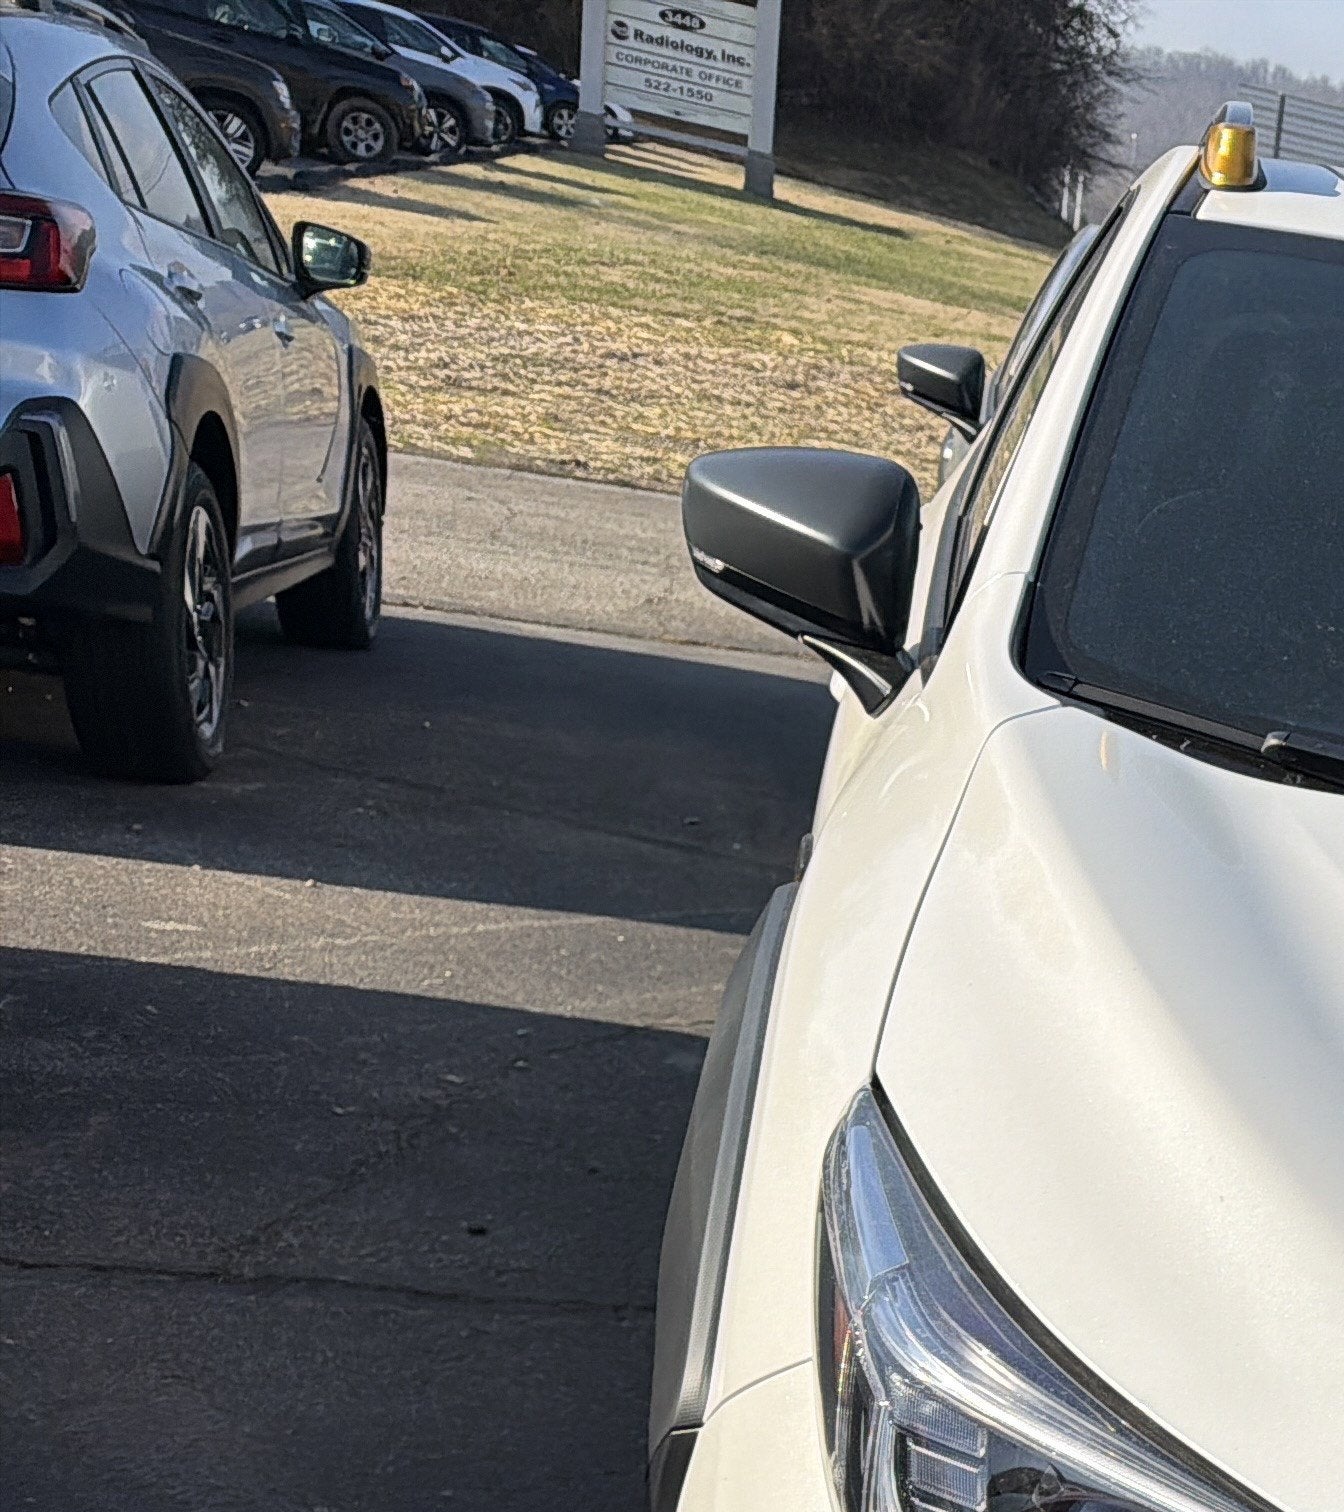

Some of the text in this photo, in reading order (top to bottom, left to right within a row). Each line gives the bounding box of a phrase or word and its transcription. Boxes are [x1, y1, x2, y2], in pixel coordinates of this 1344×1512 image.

[633, 28, 751, 68] Radiology, Inc.
[615, 51, 743, 90] CORPORATE OFFICE
[644, 77, 713, 102] 522-1550
